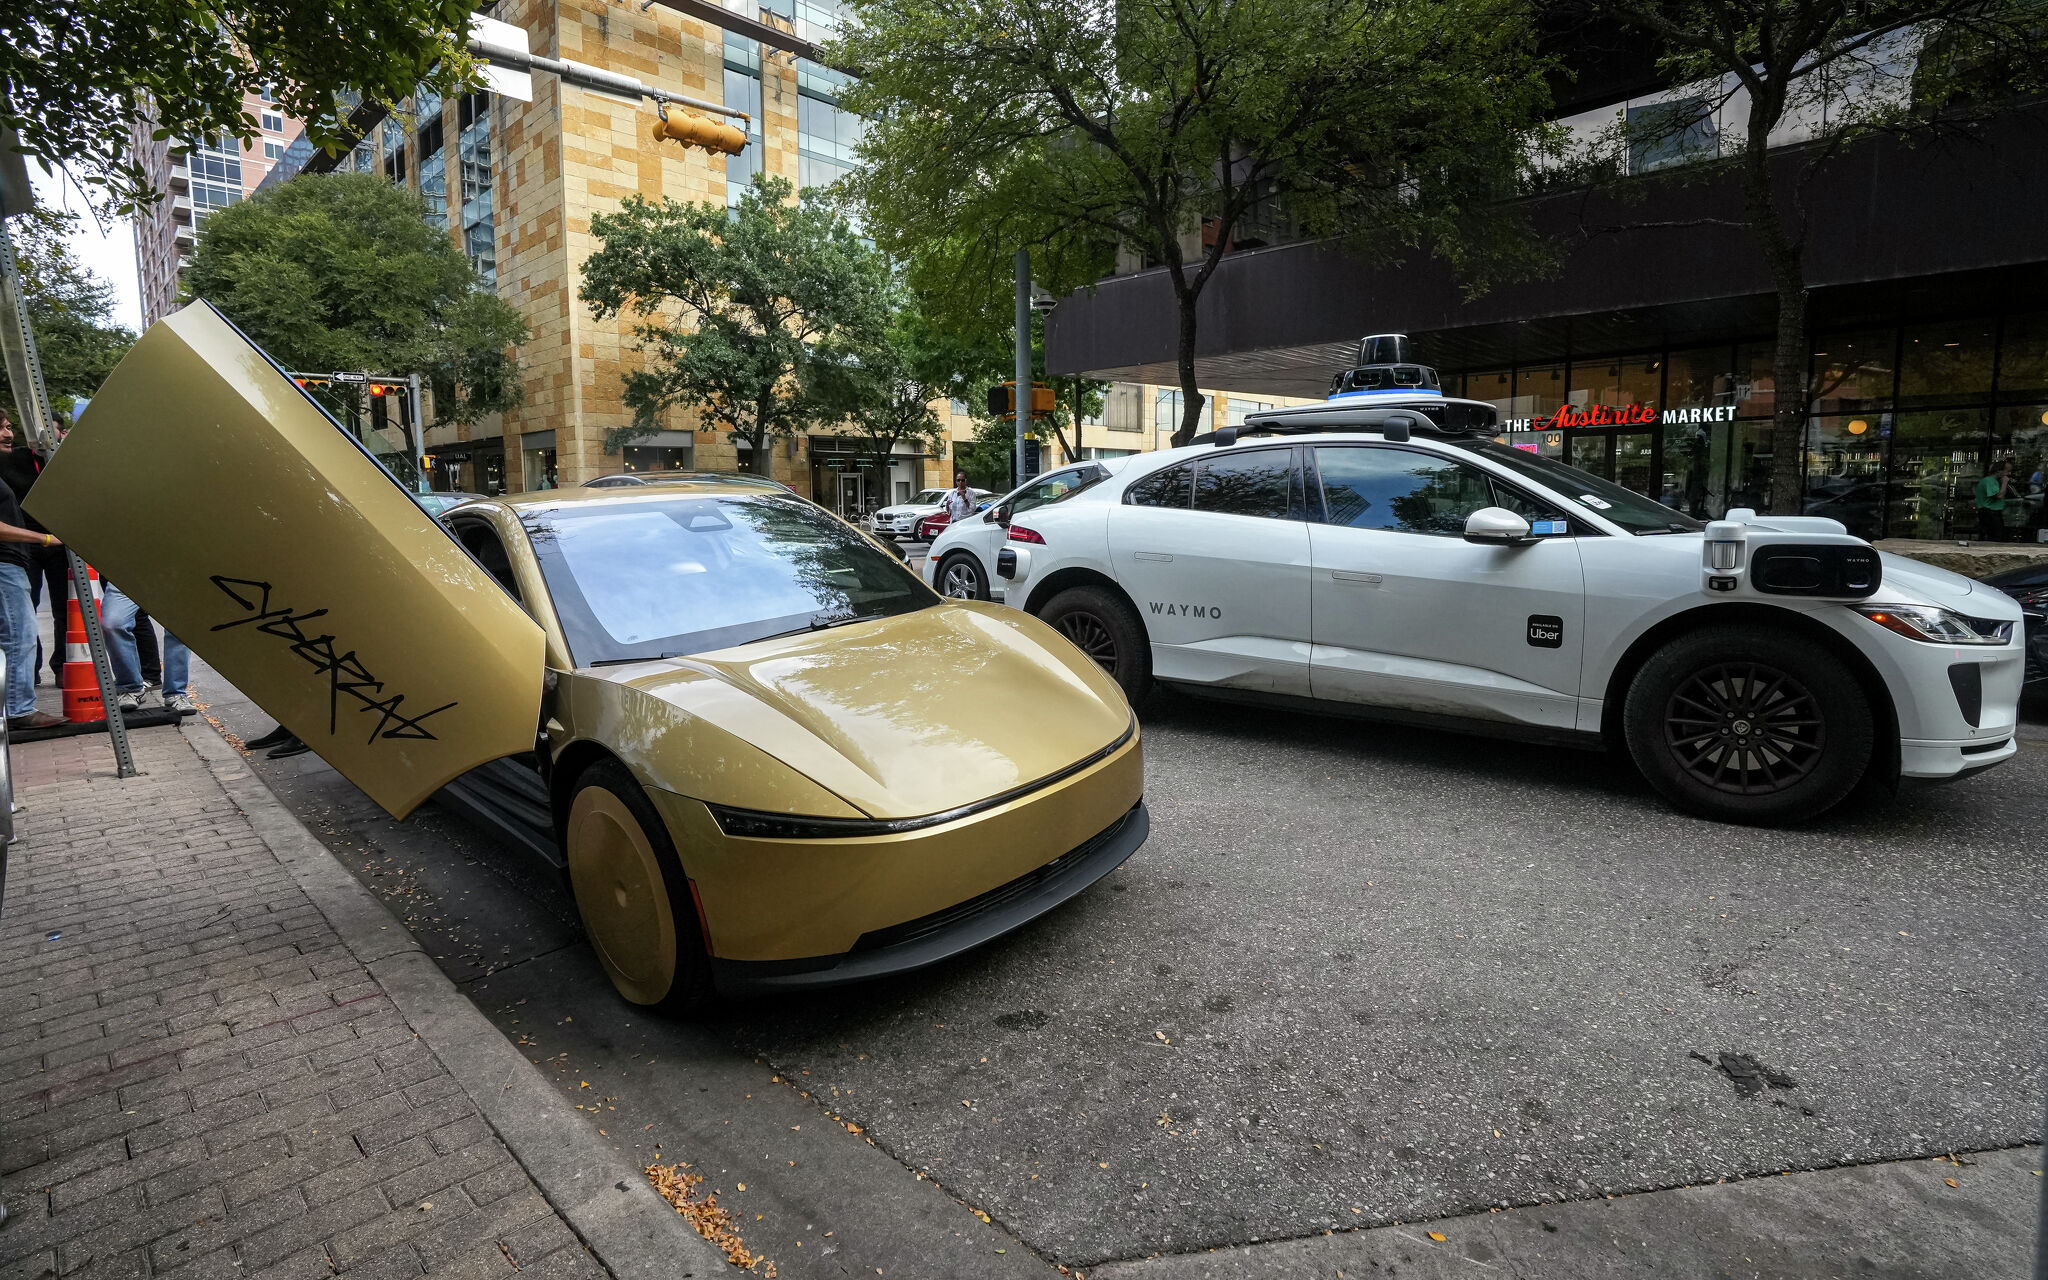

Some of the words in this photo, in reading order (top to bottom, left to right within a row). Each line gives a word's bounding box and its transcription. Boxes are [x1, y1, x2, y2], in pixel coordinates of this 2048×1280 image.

[1505, 418, 1531, 433] THE
[1533, 402, 1657, 431] Austinite
[1662, 405, 1737, 425] MARKET
[1149, 602, 1222, 619] WAYMO
[1530, 628, 1559, 640] Uber
